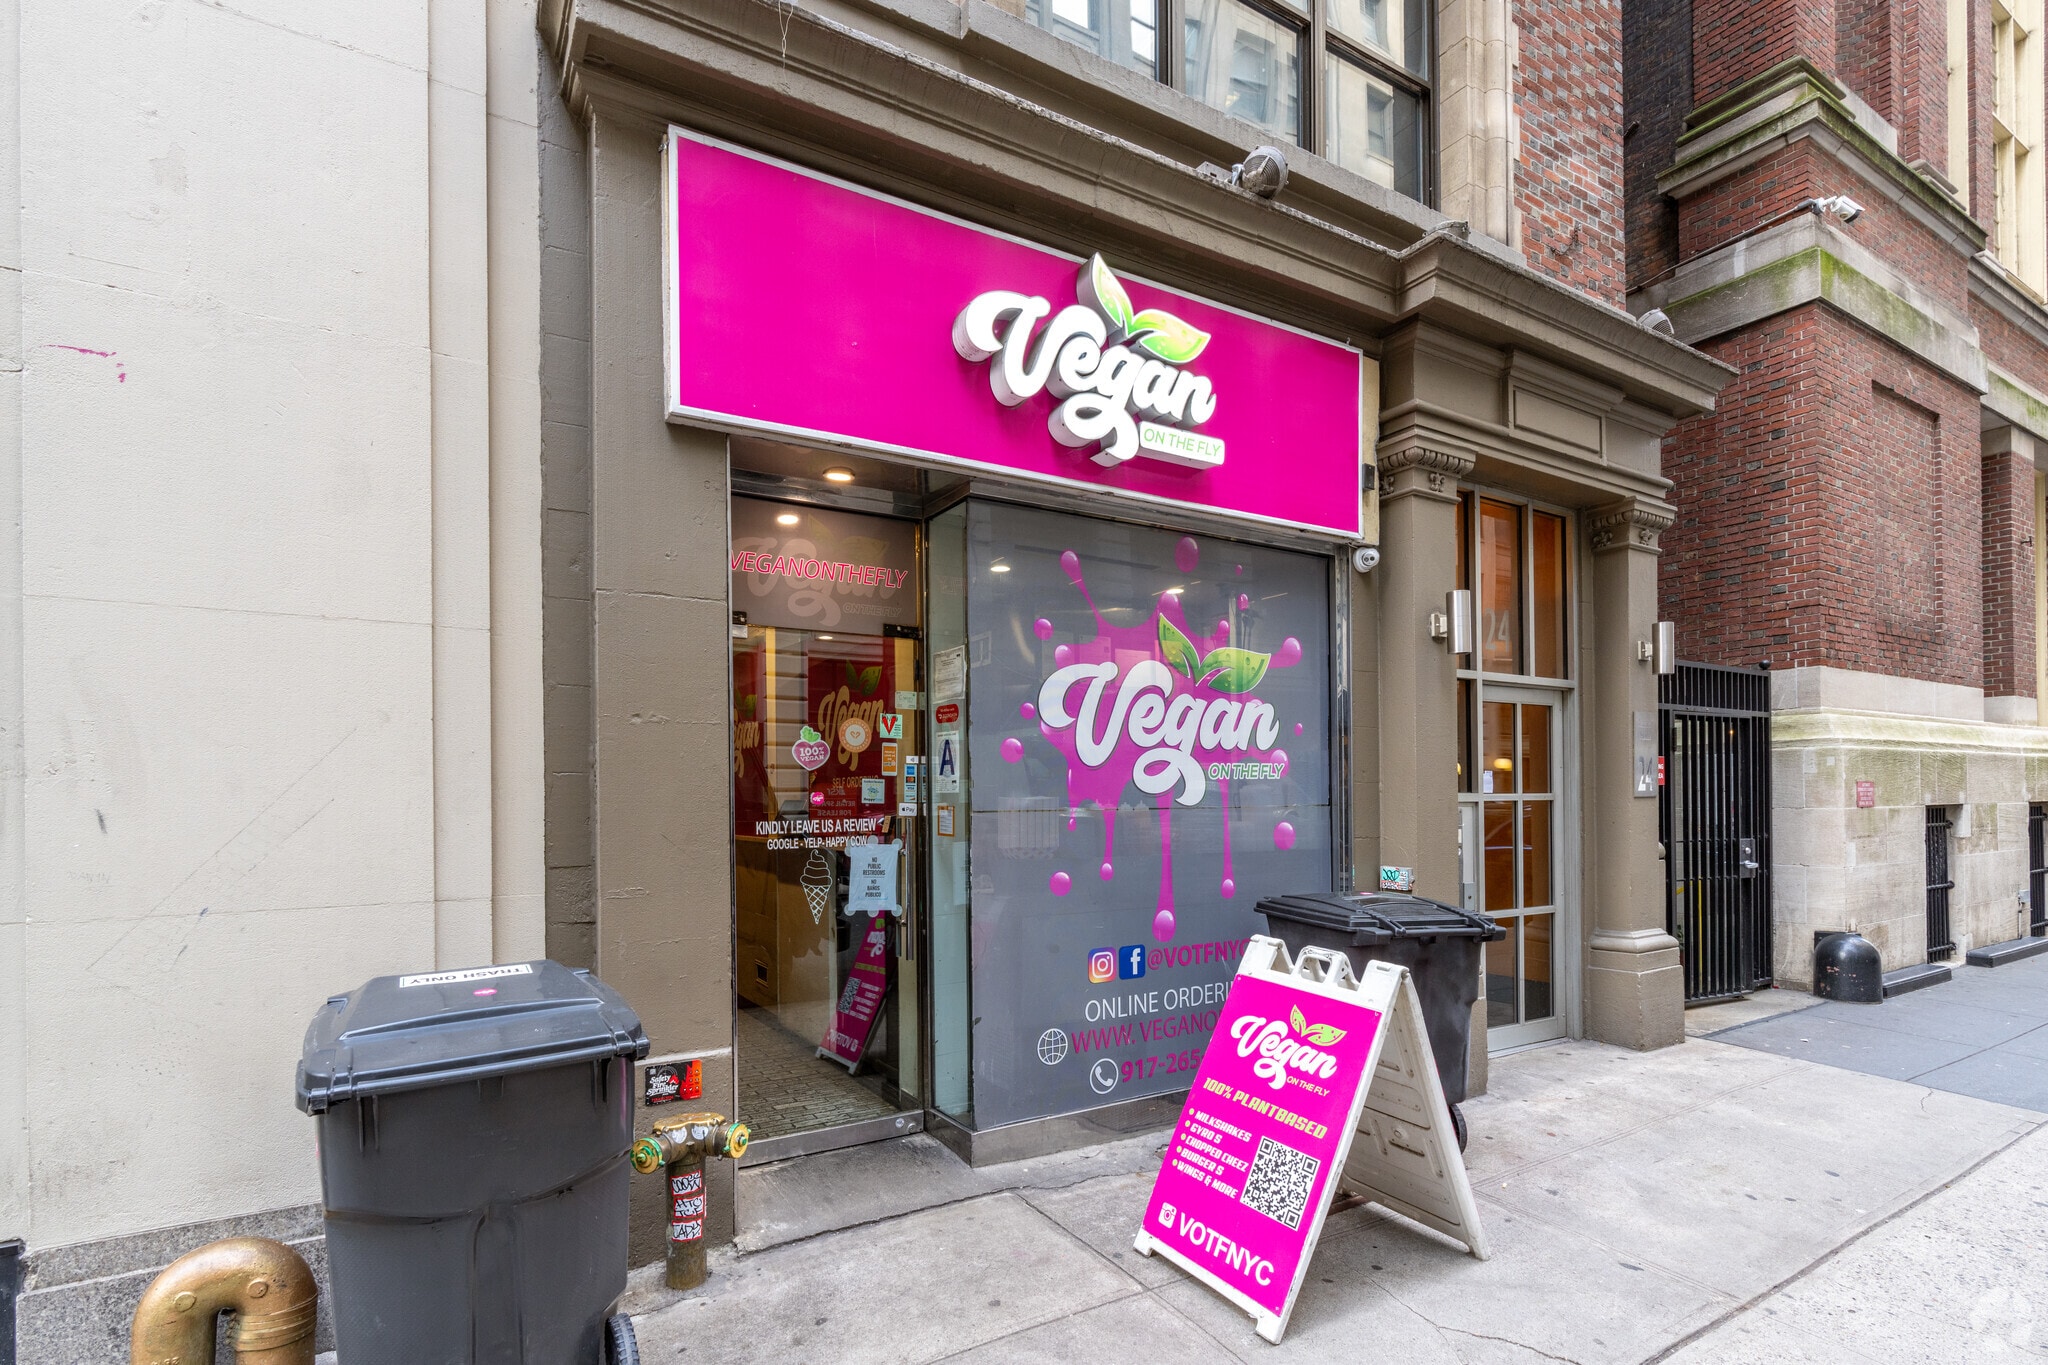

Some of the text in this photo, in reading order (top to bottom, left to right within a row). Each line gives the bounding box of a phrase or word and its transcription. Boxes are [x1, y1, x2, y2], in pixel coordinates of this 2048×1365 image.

[962, 290, 1217, 461] Vegan
[1143, 428, 1222, 458] ON THE FLY
[731, 551, 908, 589] VEGANONTHEFLY
[1485, 607, 1510, 655] 24
[1038, 660, 1280, 806] Vegan
[799, 746, 825, 757] 100%
[939, 740, 955, 775] A
[1209, 763, 1285, 780] ON THE FLY
[1638, 756, 1653, 791] 24
[756, 818, 877, 835] KINDLY LEAVE US A REVIEW
[767, 838, 799, 850] GOOGLE
[826, 836, 849, 848] HAPPY
[850, 835, 868, 848] COW
[410, 968, 522, 984] TRASH ONLY
[1085, 981, 1234, 1022] ONLINE ORDERI
[1139, 1009, 1222, 1042] VEGANO
[1230, 1015, 1338, 1090] Vegan
[646, 1084, 679, 1096] Sprinkler
[650, 1074, 671, 1084] Safety
[652, 1081, 666, 1090] Fire
[1287, 1076, 1330, 1097] ON THE FLY
[1203, 1077, 1328, 1140] 100% PLANTBASED
[1189, 1123, 1215, 1141] GYRO
[1194, 1110, 1252, 1142] MILKSHAKES
[1181, 1148, 1215, 1172] BURGER
[1185, 1135, 1250, 1173] CHOPPED CHEEZ
[1177, 1160, 1239, 1199] WINGS & MORE
[1179, 1212, 1275, 1287] VOTFNYC
